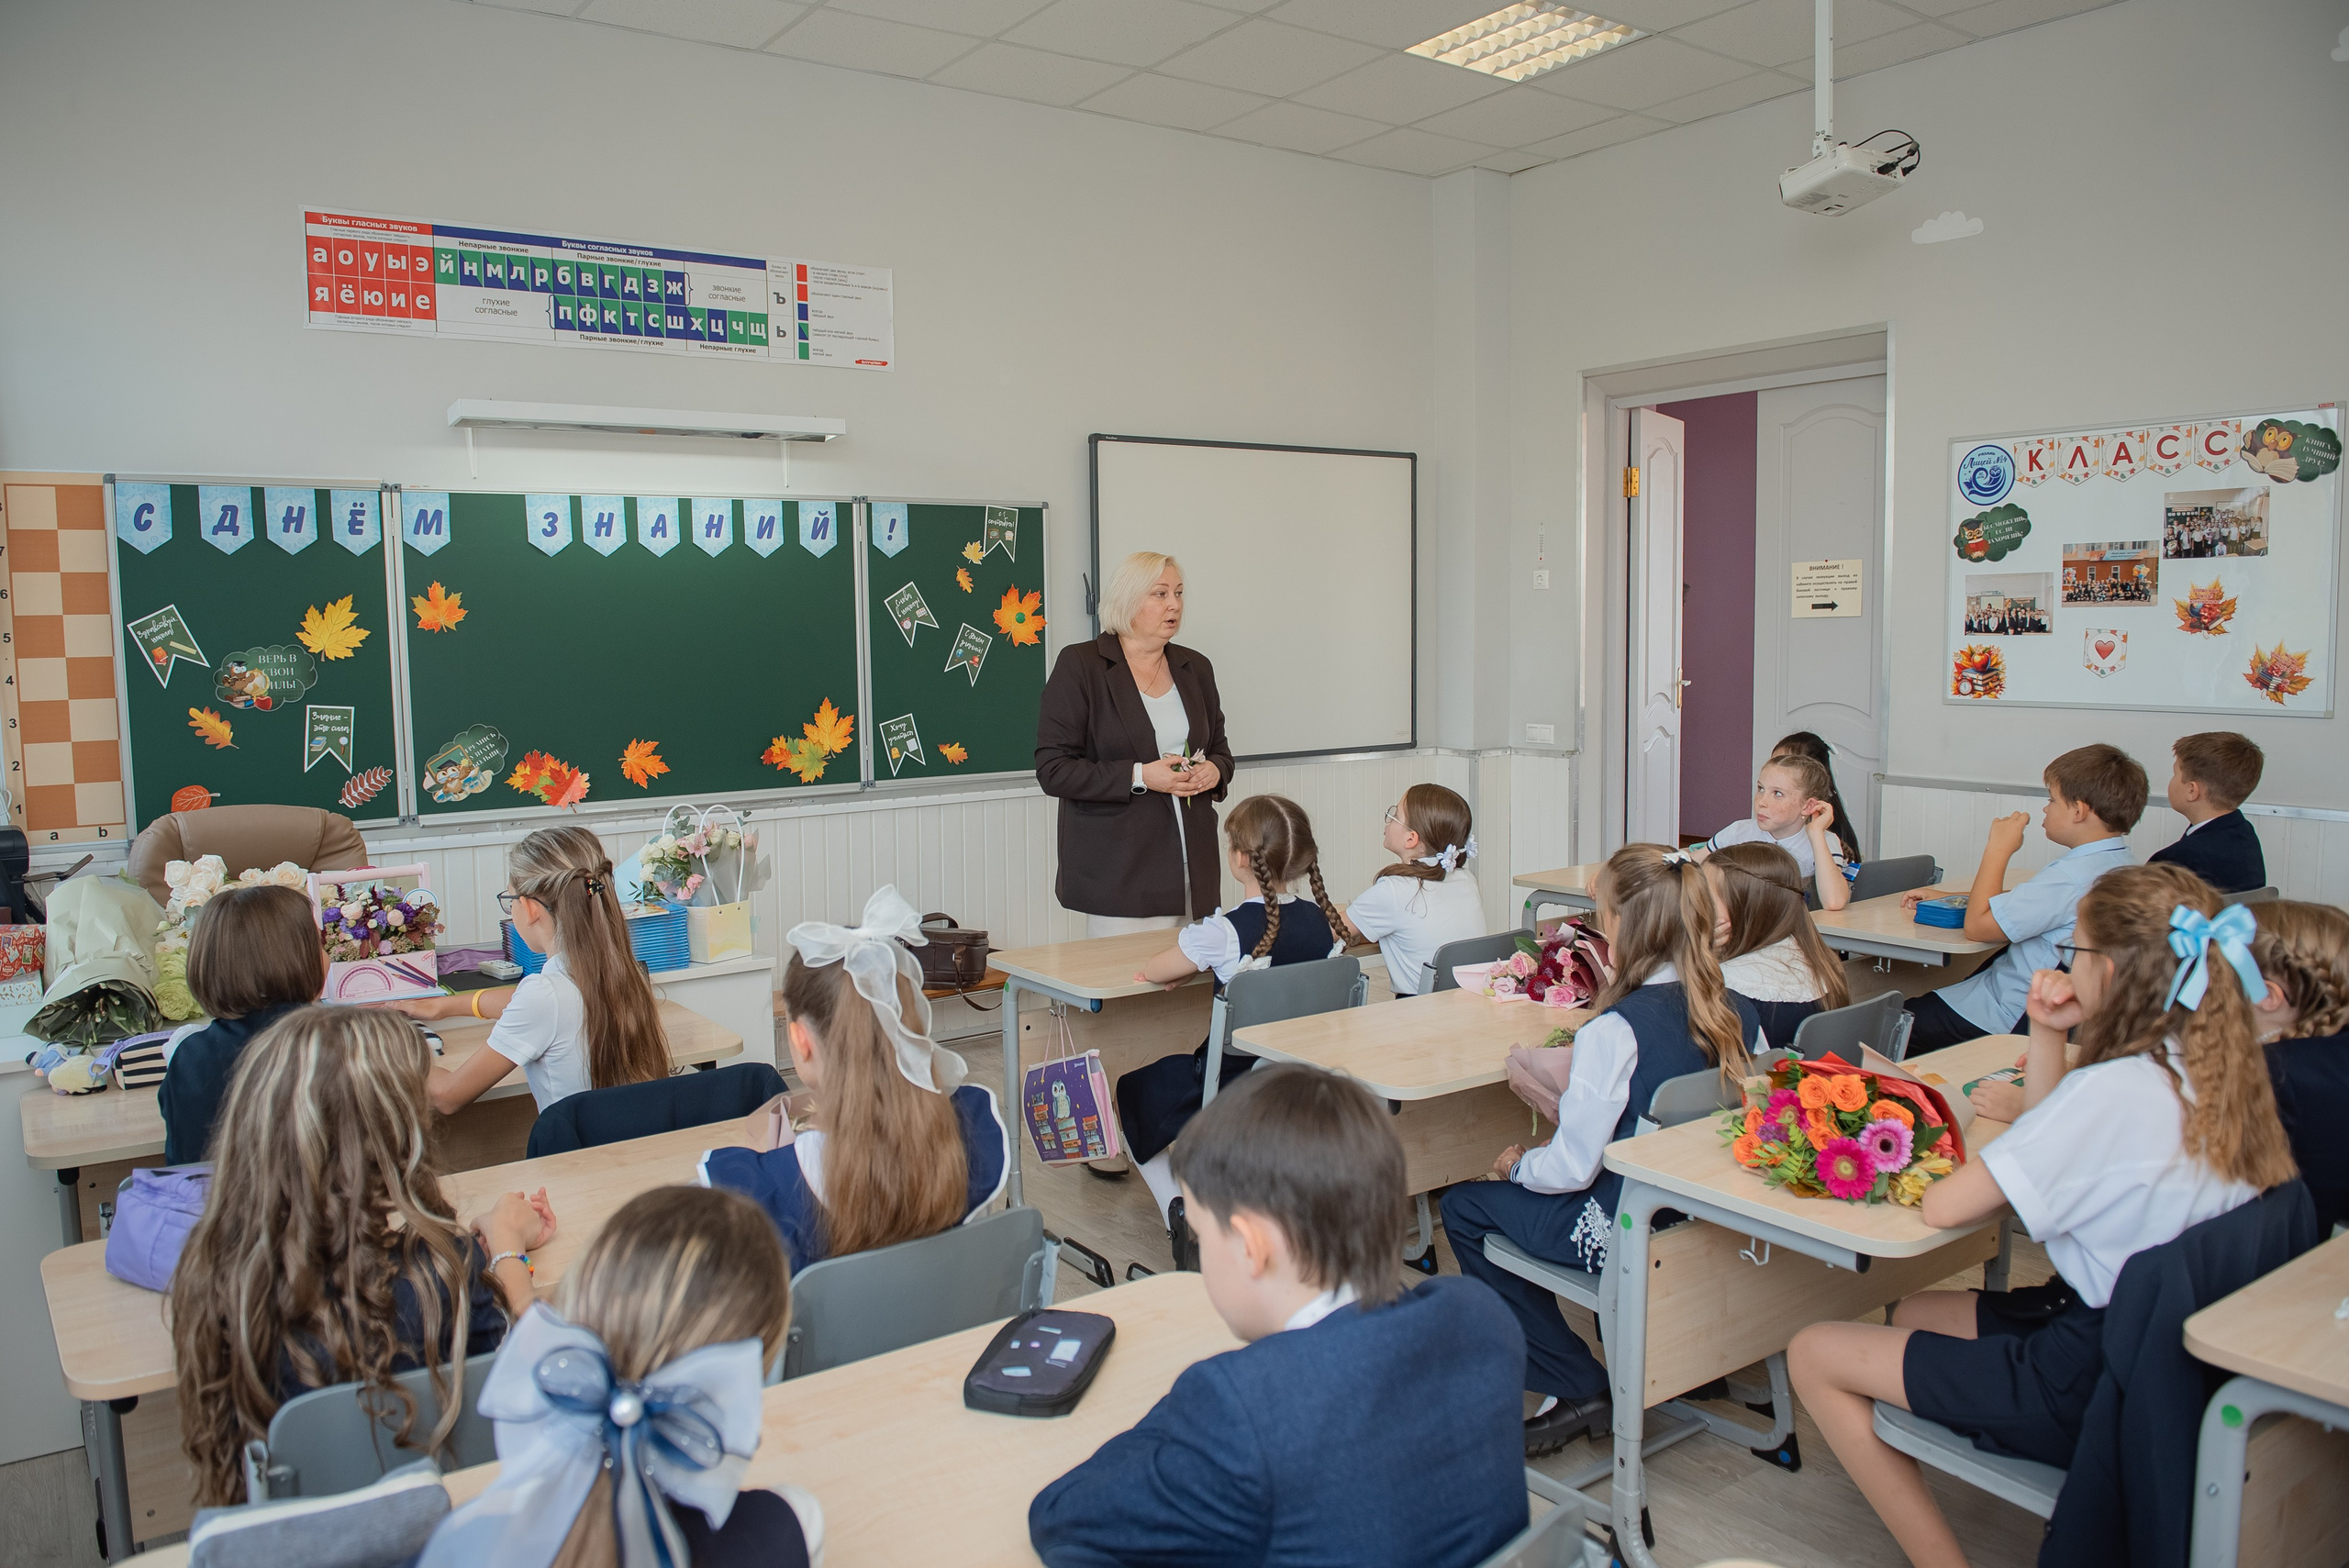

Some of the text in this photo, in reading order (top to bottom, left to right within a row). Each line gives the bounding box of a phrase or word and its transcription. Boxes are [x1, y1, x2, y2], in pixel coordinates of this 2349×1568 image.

[322, 216, 417, 232] Буквы гласных звуков
[459, 240, 529, 254] Непарные звонкие
[562, 239, 653, 257] Буквы согласных звуков
[577, 252, 662, 267] Парные звонкие/глухие
[313, 247, 684, 295] а о у ы э й н м л р б в г д з ж
[712, 285, 741, 294] звонкие
[482, 297, 510, 306] глухие
[708, 294, 746, 302] согласные
[315, 284, 766, 339] я ё ю и е п ф к т с ш х ц ч щ
[474, 306, 518, 317] согласные
[580, 334, 664, 347] Парные звонкие/глухие
[700, 343, 733, 351] Непарные
[2028, 430, 2229, 473] КЛАСС
[1964, 457, 1992, 469] Лицей
[132, 502, 155, 532] С
[0, 589, 8, 599] 6
[3, 633, 11, 643] 5
[258, 653, 297, 663] ВЕРЬ В
[262, 667, 294, 676] СВОИ
[6, 675, 14, 685] 4
[312, 711, 341, 722] Знание
[9, 718, 17, 728] 3
[12, 761, 20, 772] 2
[16, 805, 22, 815] 1
[50, 827, 108, 840] a b
